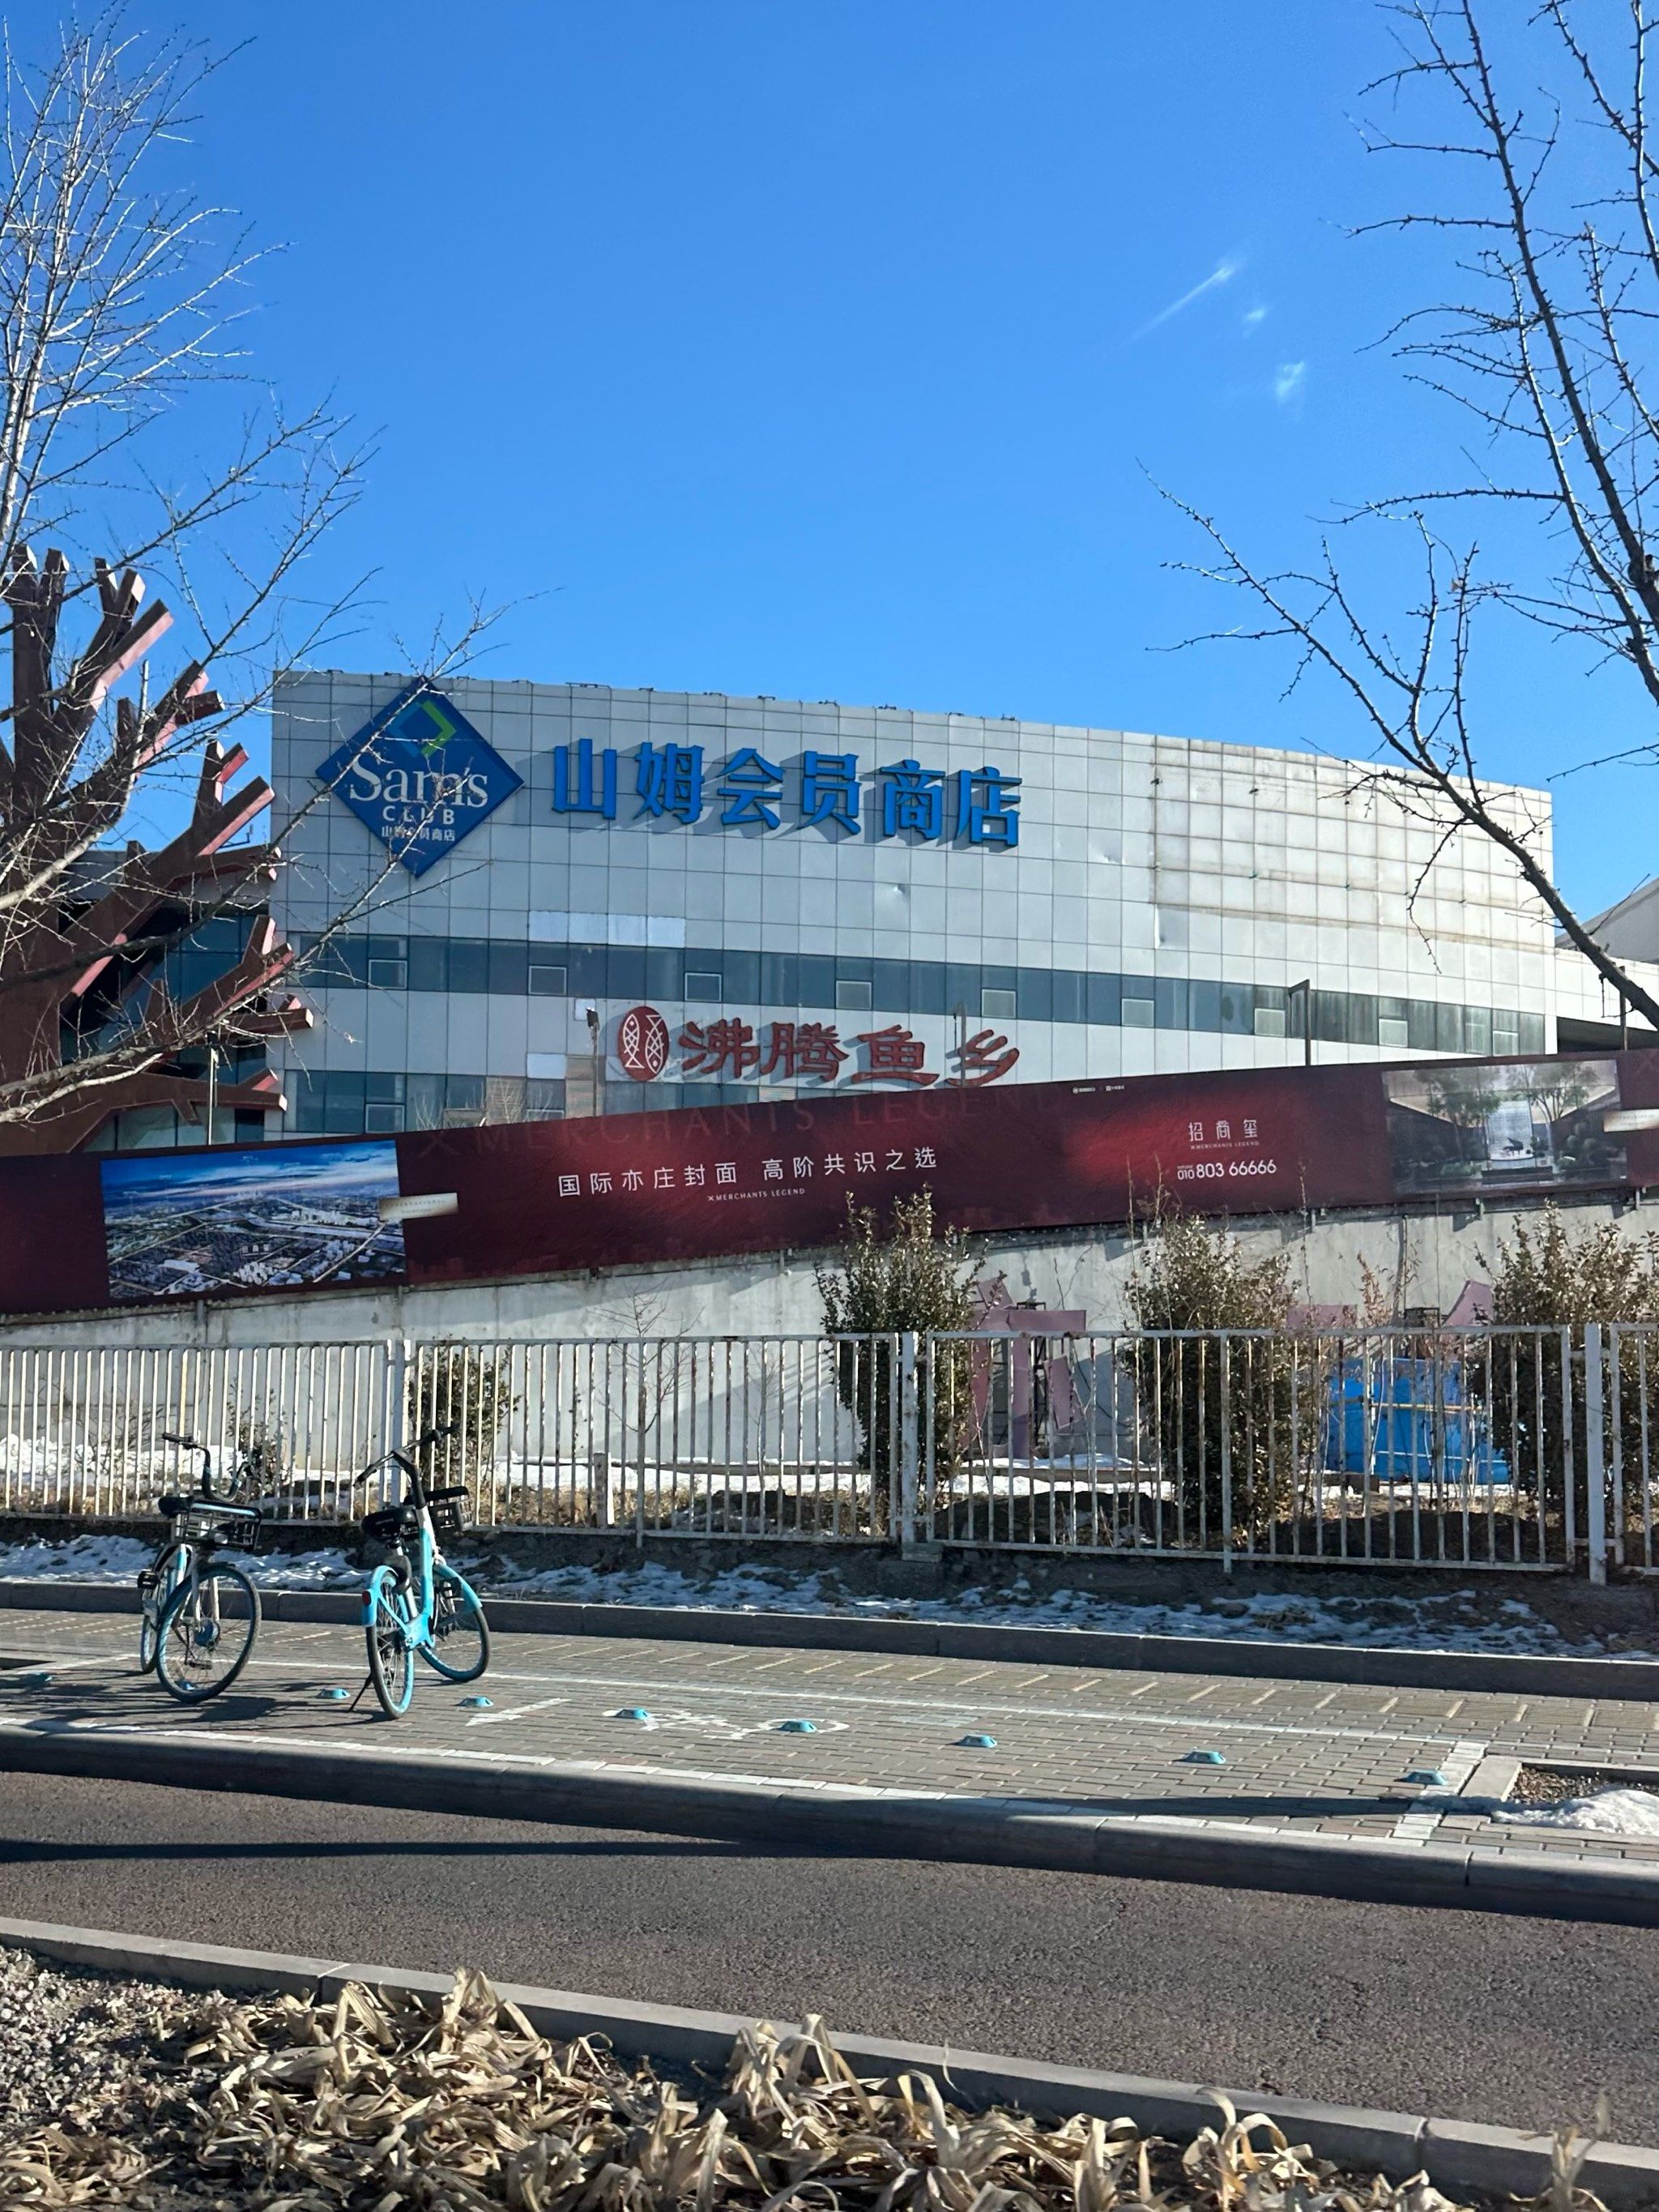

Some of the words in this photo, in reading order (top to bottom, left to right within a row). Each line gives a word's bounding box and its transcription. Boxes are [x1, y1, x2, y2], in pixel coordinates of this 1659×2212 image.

[349, 755, 488, 808] Sam's
[552, 738, 1022, 847] 山姆会员商店
[382, 805, 455, 825] CLUB
[678, 1018, 1020, 1087] 沸腾鱼乡
[1188, 1119, 1258, 1142] 招商玺
[558, 1162, 737, 1198] 国际亦庄封面
[761, 1147, 937, 1181] 高阶共识之选
[1229, 1159, 1277, 1176] 66666
[715, 1190, 768, 1201] MERCHANTS
[771, 1188, 805, 1197] LEGEND
